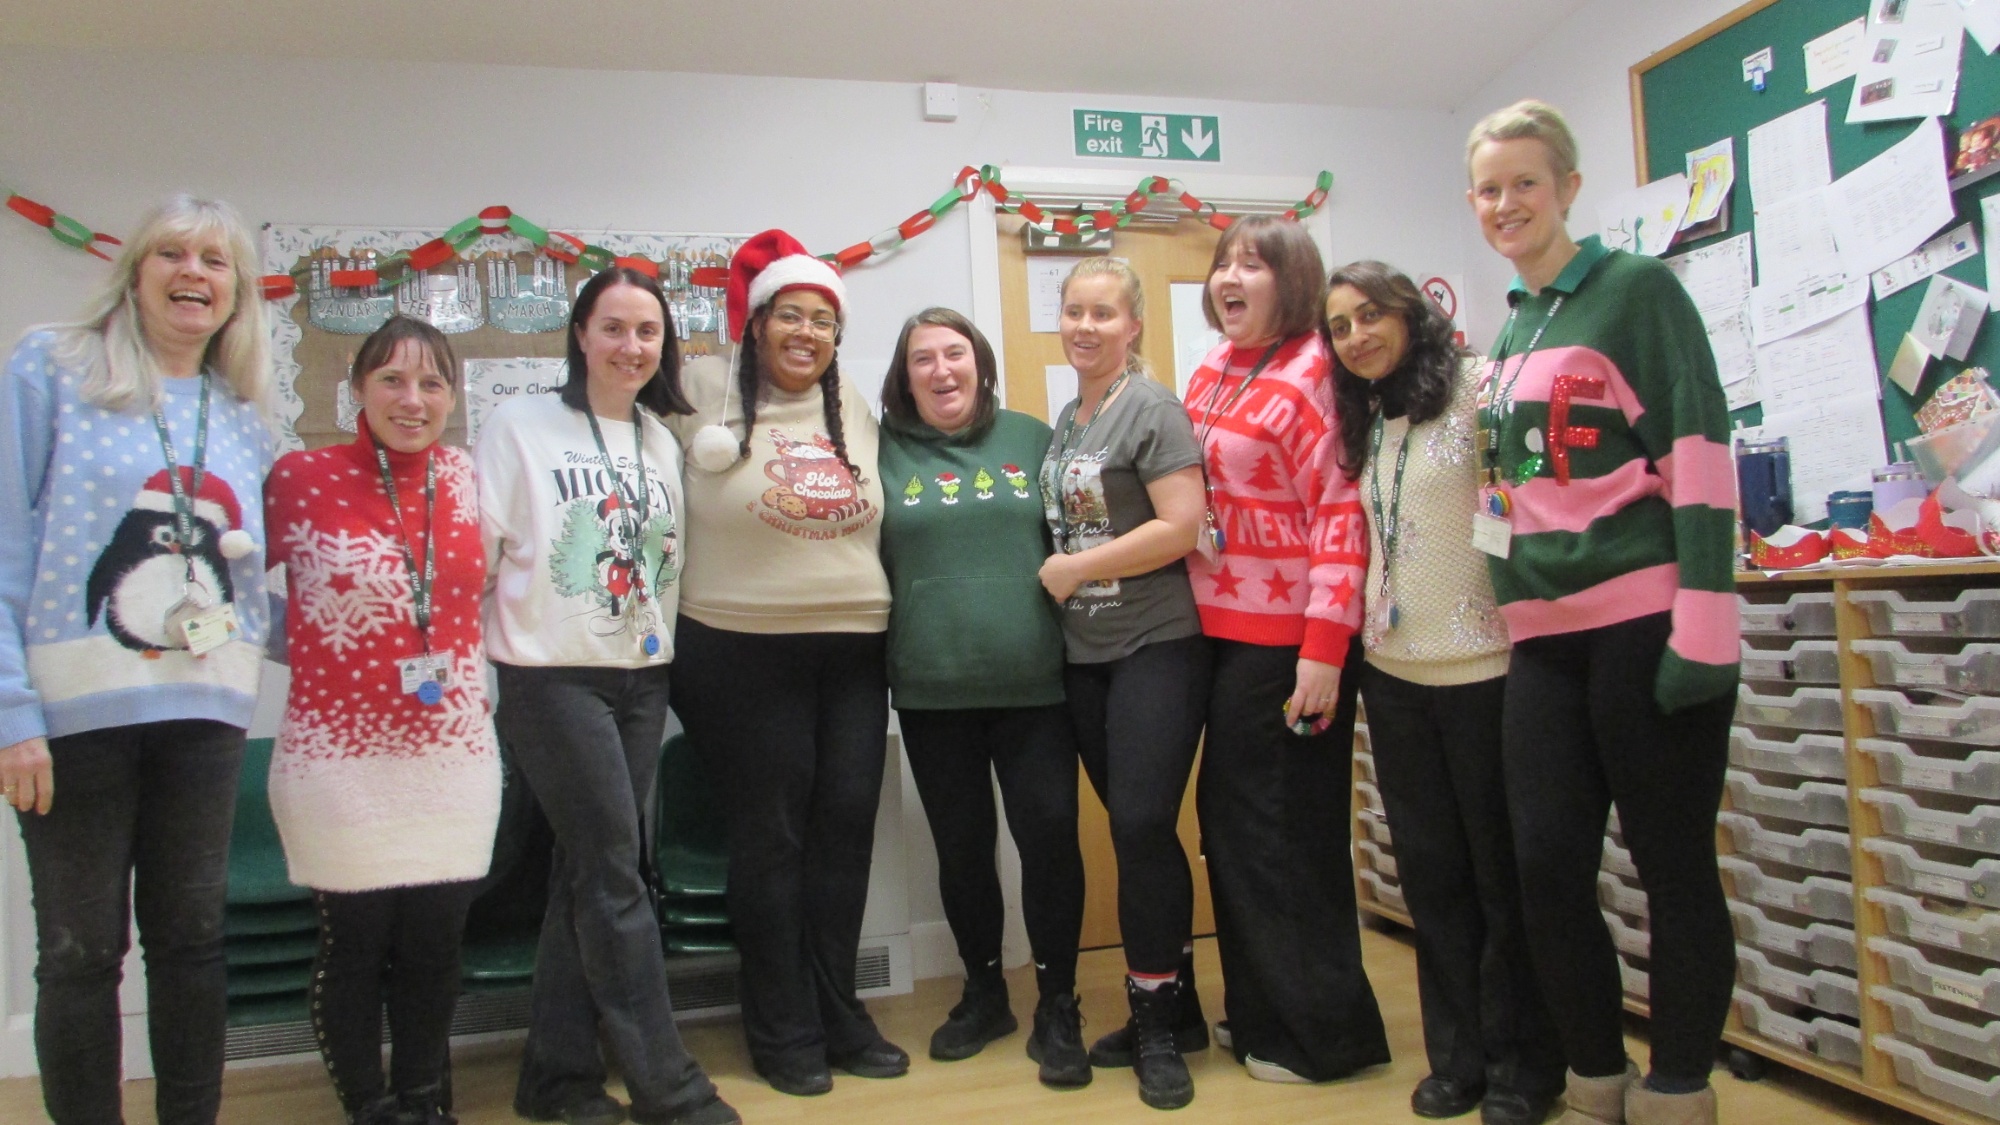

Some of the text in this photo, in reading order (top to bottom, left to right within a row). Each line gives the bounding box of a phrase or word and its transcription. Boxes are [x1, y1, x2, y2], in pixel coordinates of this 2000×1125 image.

[1083, 114, 1124, 133] Fire
[1086, 136, 1124, 154] exit
[319, 300, 381, 318] JANUARY
[409, 300, 475, 318] FEBARY
[507, 301, 552, 318] MARCH
[1547, 296, 1563, 317] STAFF
[1529, 328, 1543, 349] STAFF
[492, 383, 520, 395] Our
[1490, 429, 1498, 450] STAFF
[377, 449, 389, 469] STAFF
[564, 450, 658, 476] Winte Seaon
[601, 452, 612, 470] STAFF
[1398, 451, 1406, 470] STAFF
[428, 470, 436, 489] STAFF
[612, 479, 621, 496] STAFF
[804, 471, 840, 487] Hot
[793, 482, 852, 500] Chocolate
[759, 510, 838, 541] CHRISTMAS
[841, 504, 878, 537] MOVIES
[411, 571, 421, 592] STAFF
[423, 592, 431, 613] STAFF
[1088, 601, 1122, 617] year
